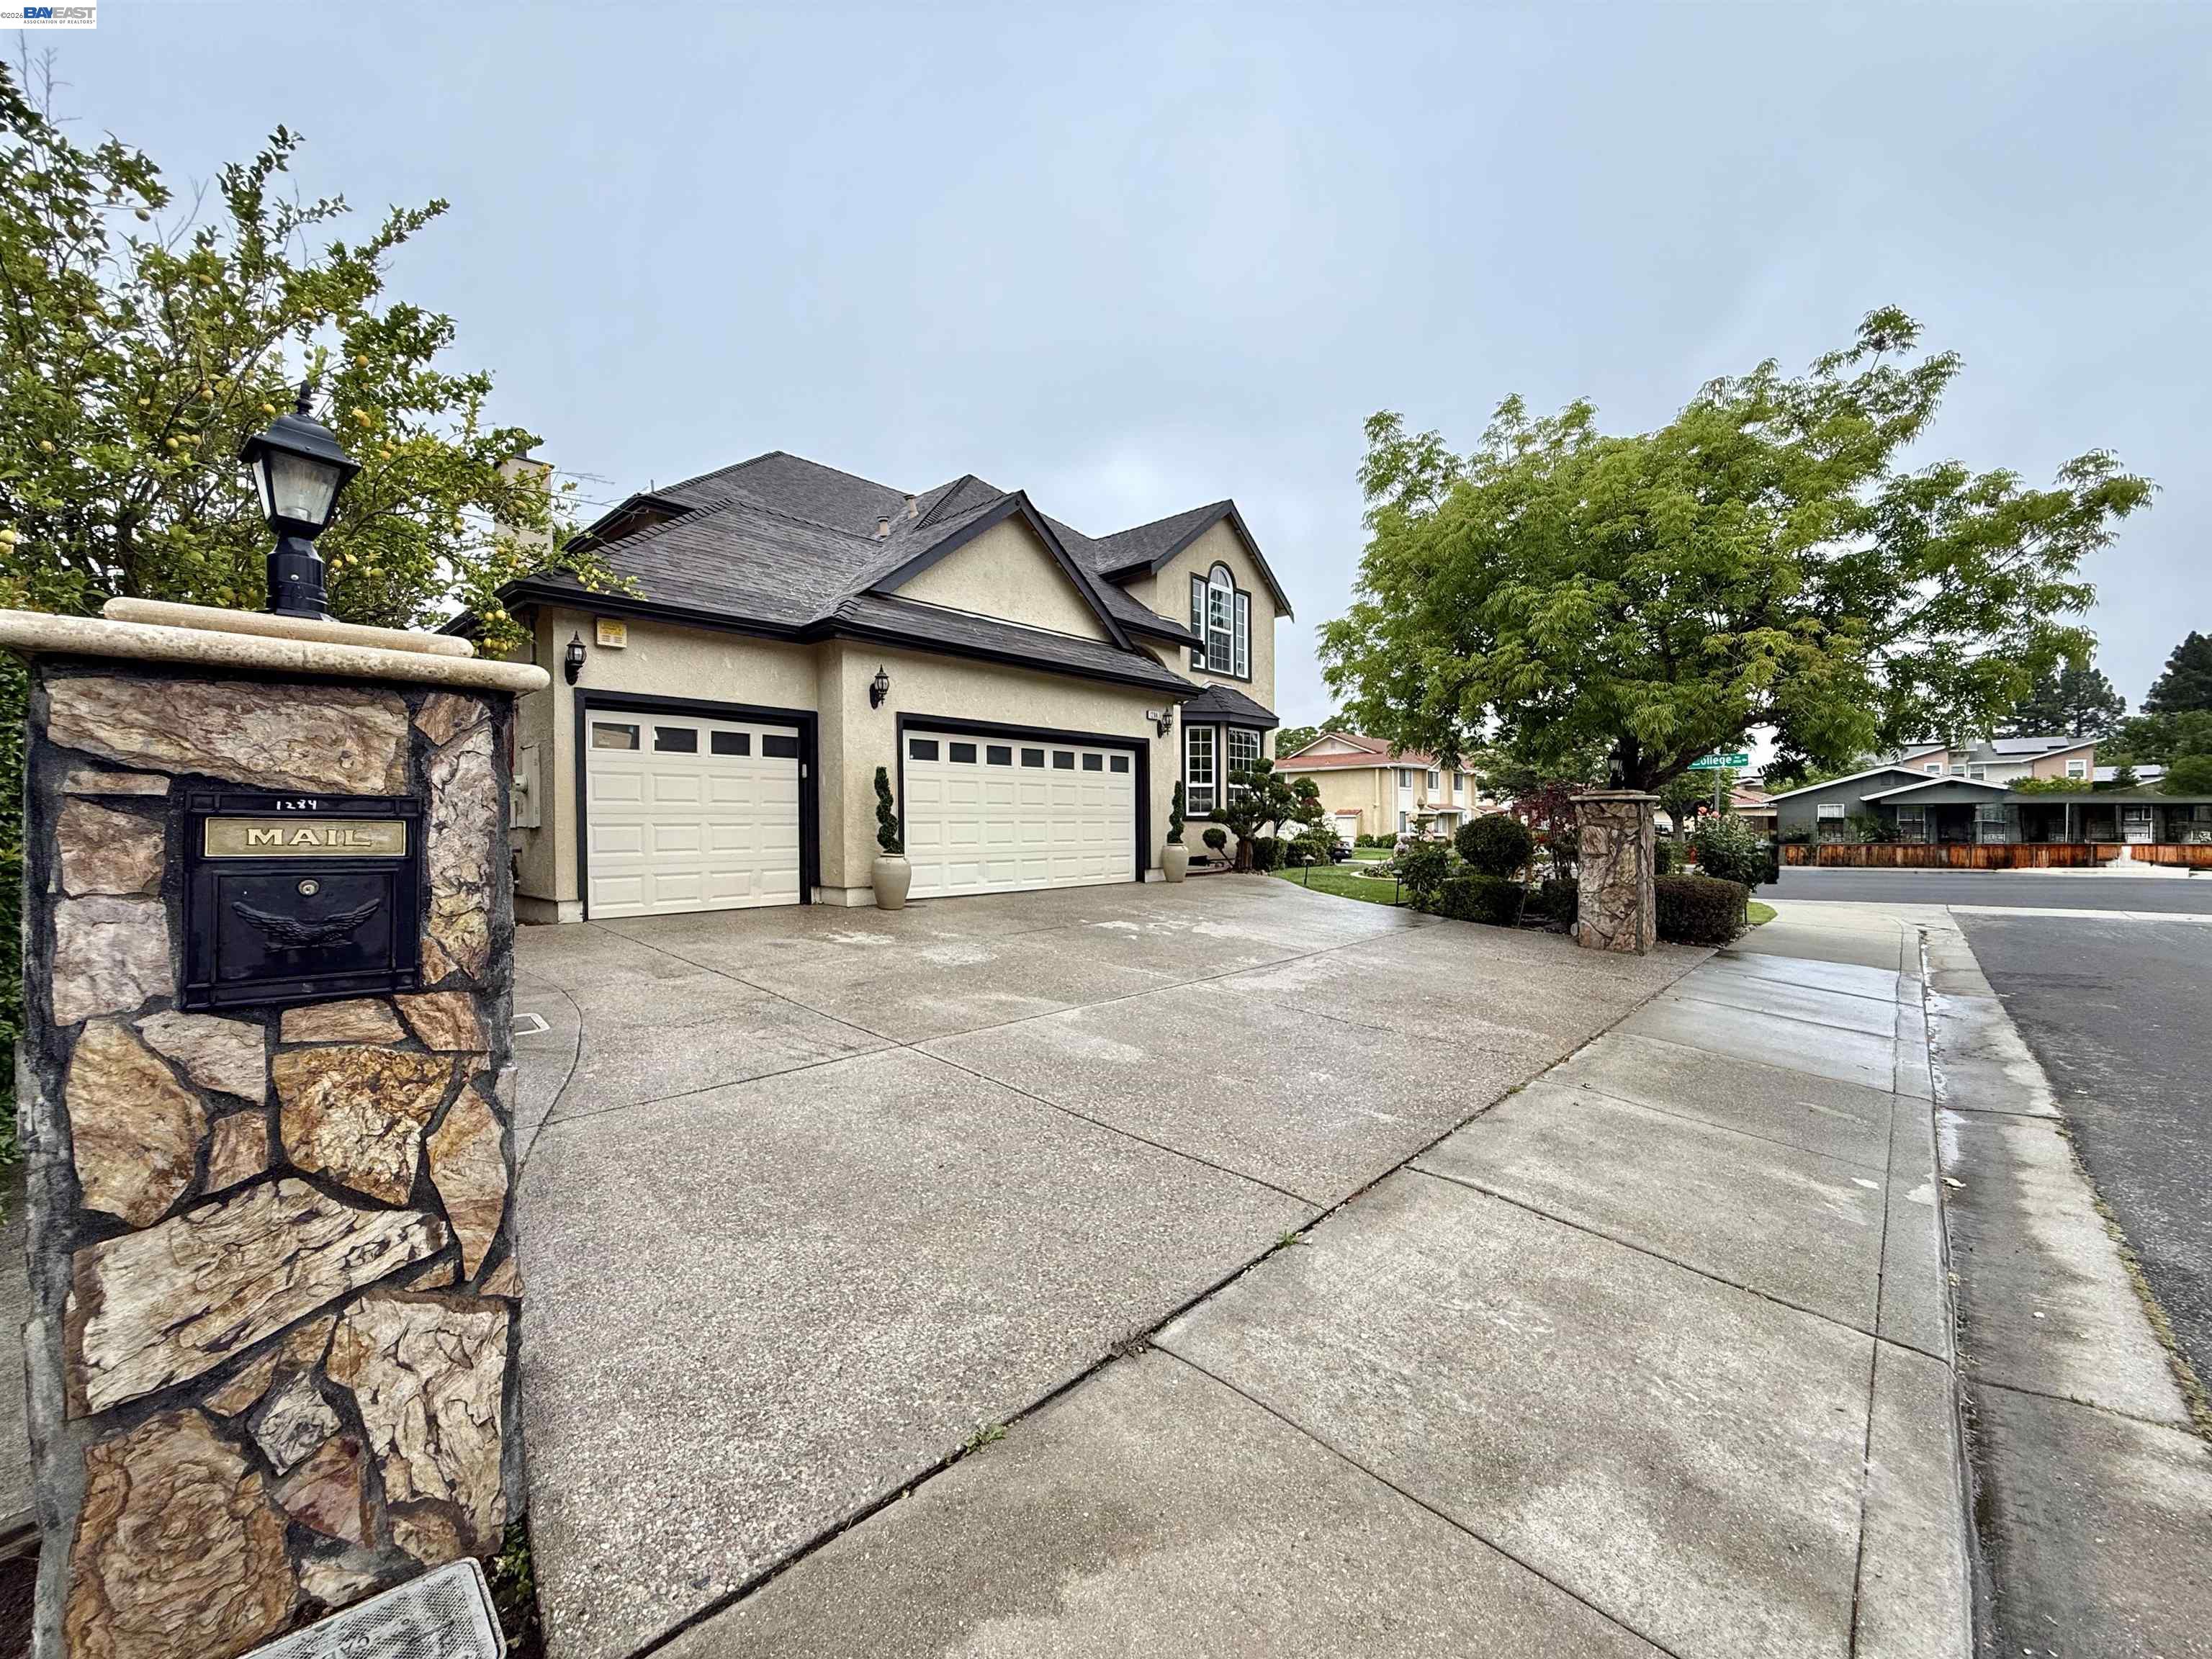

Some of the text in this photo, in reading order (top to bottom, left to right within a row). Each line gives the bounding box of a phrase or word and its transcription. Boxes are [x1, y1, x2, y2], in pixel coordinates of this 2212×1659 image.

[1692, 756, 1732, 767] ollege
[276, 799, 317, 810] 1284
[246, 828, 372, 846] MAIL
